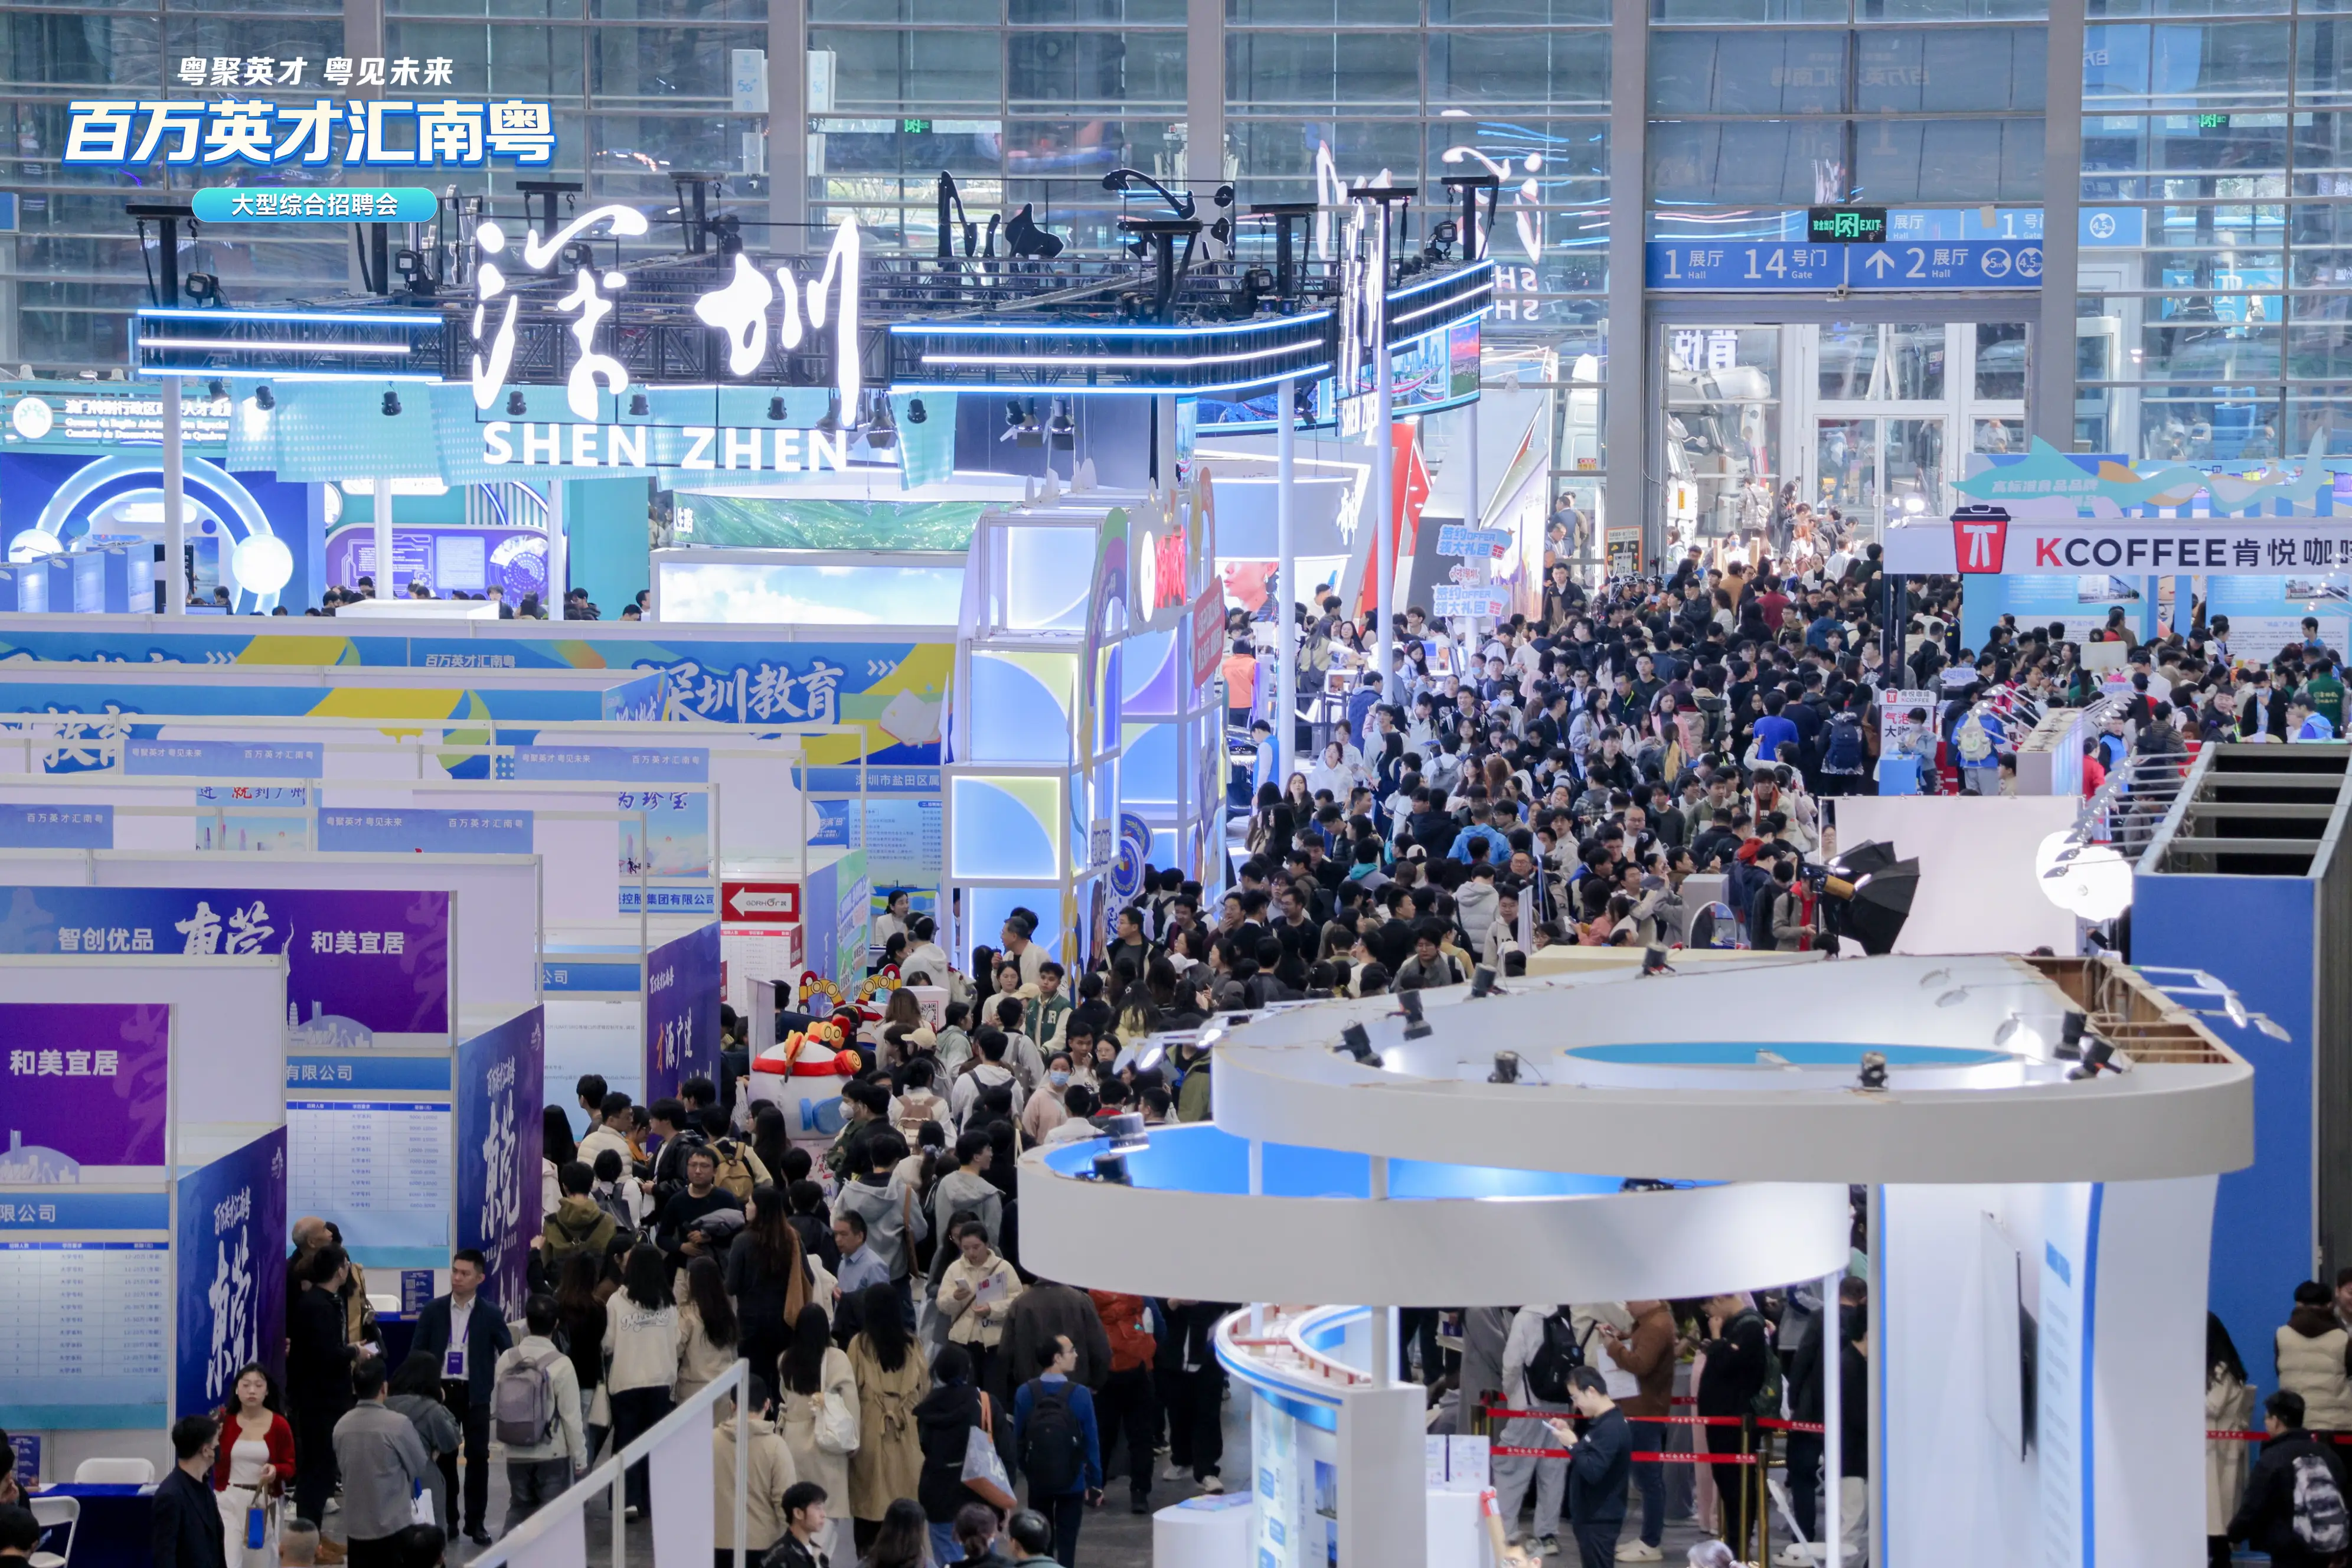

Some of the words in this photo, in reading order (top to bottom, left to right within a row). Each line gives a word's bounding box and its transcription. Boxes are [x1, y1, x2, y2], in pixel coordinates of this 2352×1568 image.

[1813, 220, 1834, 231] 安全出口
[1860, 220, 1881, 231] EXIT
[1894, 215, 1924, 229] 展厅
[2002, 214, 2017, 239] 1
[2024, 214, 2044, 228] 号
[1664, 249, 1681, 279] 1
[1688, 250, 1724, 267] 展厅
[1744, 249, 1787, 279] 14
[1792, 249, 1827, 267] 号门
[1906, 247, 1926, 278] 2
[1933, 249, 1969, 266] 展厅
[1989, 258, 2003, 269] 5m
[1688, 271, 1706, 279] Hall
[1792, 271, 1812, 279] Gate
[472, 205, 860, 426] 深圳
[483, 422, 646, 468] SHEN
[681, 427, 848, 472] ZHEN
[2036, 538, 2226, 566] KCOFFEE
[425, 654, 516, 668] 百万英才汇南粤
[132, 748, 165, 757] 粤聚英才
[168, 749, 202, 757] 粤见未来
[244, 749, 313, 760] 百万英才汇南粤
[522, 753, 555, 762] 粤聚英才
[558, 754, 590, 763] 粤见未来
[632, 755, 700, 765] 百万英才汇南粤
[27, 813, 104, 825] 百万英才汇南粤
[326, 817, 363, 827] 粤聚英才
[366, 818, 402, 827] 粤见未来
[448, 818, 524, 829] 百万英才汇南粤
[619, 893, 714, 906] 控股集团有限公司
[58, 927, 153, 952] 智创优品
[311, 930, 405, 955] 和美宜居
[542, 970, 568, 985] 公司
[9, 1049, 119, 1077] 和美宜居
[286, 1064, 352, 1082] 有限公司
[0, 1204, 56, 1223] 限公司
